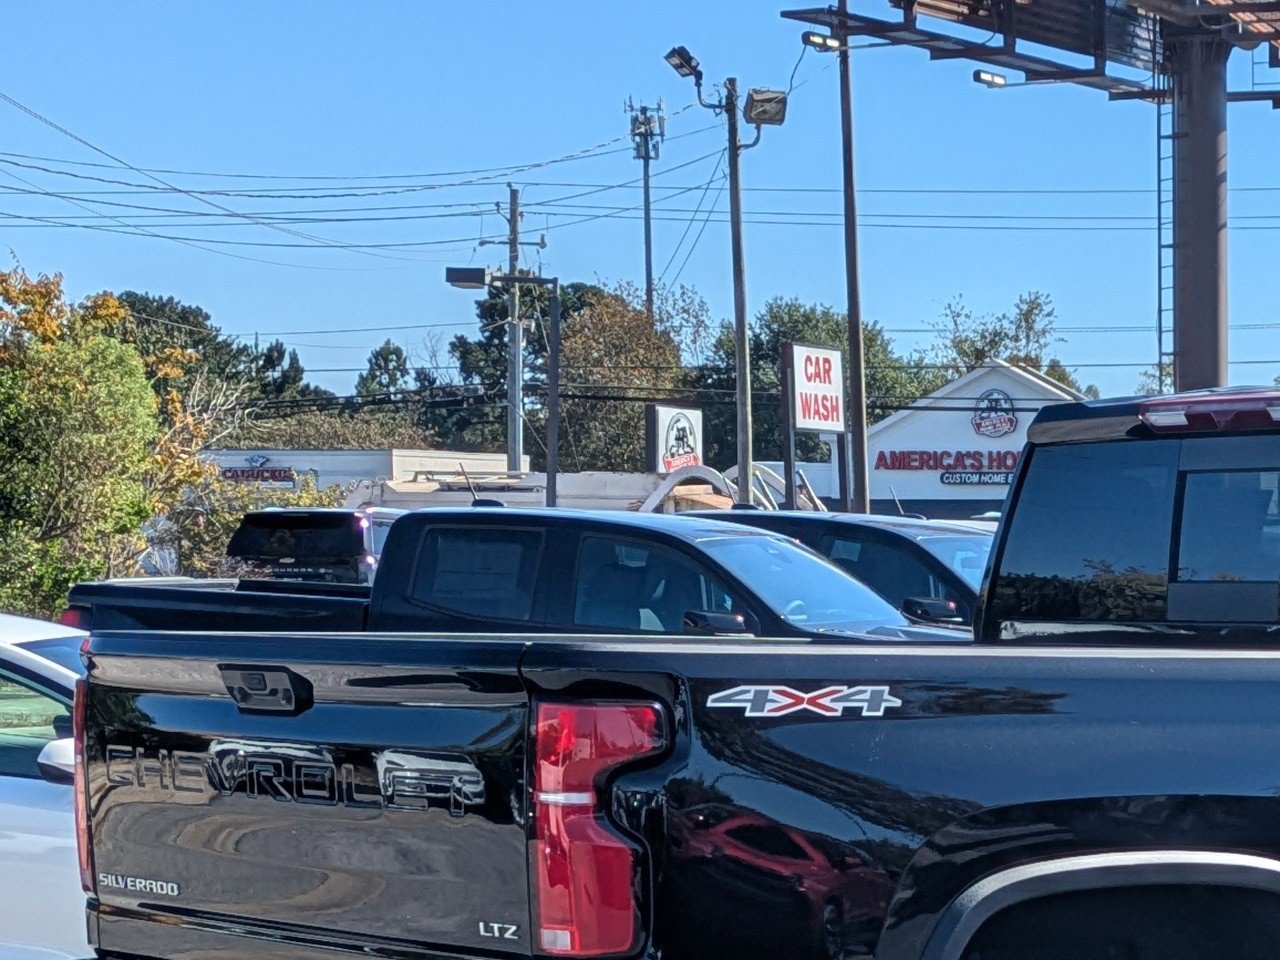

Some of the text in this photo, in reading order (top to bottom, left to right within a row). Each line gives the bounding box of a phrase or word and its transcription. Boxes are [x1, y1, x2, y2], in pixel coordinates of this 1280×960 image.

[804, 354, 832, 385] CAR
[800, 391, 840, 423] WASH
[874, 450, 1025, 471] AMERICA'S HO
[943, 473, 979, 484] CUSTOM
[981, 473, 1006, 484] HOME
[106, 743, 480, 817] CHEVROLET
[98, 872, 178, 896] SILVERADO
[479, 921, 519, 939] LTZ
